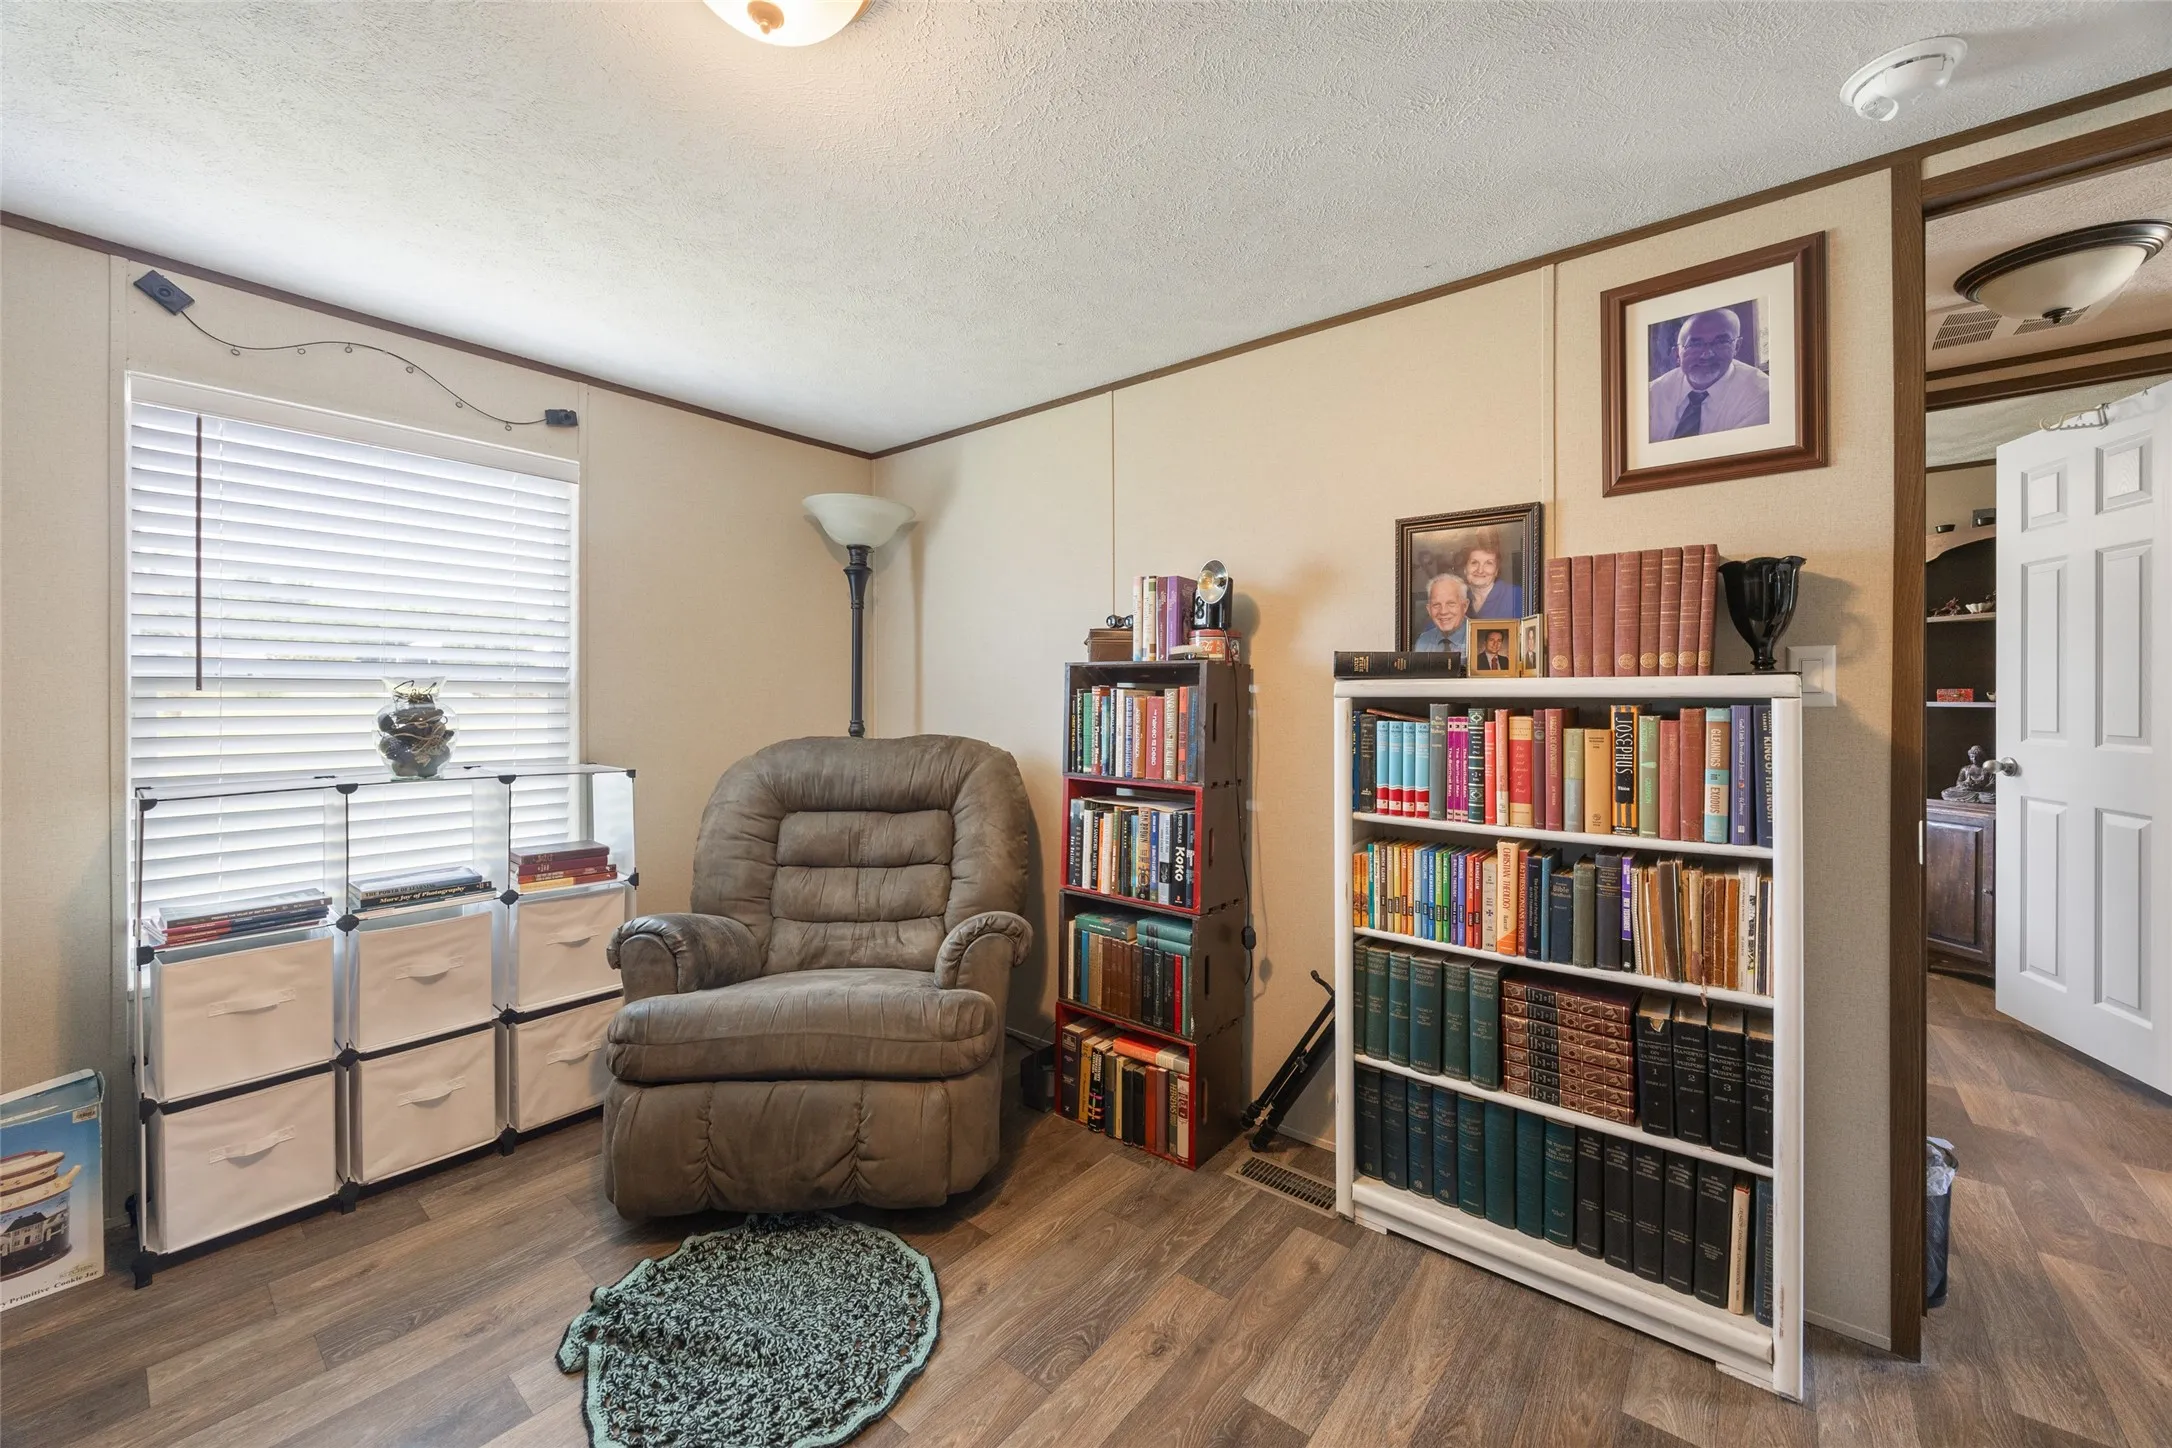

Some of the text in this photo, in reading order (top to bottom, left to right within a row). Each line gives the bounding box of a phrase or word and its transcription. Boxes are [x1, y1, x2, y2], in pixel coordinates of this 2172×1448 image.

[1165, 691, 1175, 766] SANDRA BROWN THE ALIBI
[1549, 716, 1557, 737] TARGETS
[1615, 717, 1633, 774] JOSEPHUS
[1710, 728, 1722, 768] GLEANINGS
[1763, 736, 1773, 762] KING
[1549, 744, 1557, 777] OPPORTUNITY
[1764, 763, 1773, 773] OF
[1710, 773, 1720, 781] in
[1765, 776, 1773, 792] THE
[1709, 786, 1721, 814] EXODUS
[1140, 810, 1149, 844] DAN BROWN
[1174, 846, 1186, 882] KOKO
[1502, 847, 1512, 879] CHRISTIAN
[378, 888, 399, 896] POWER
[408, 883, 436, 892] LEARNING
[379, 896, 398, 904] More
[398, 894, 411, 902] Joy
[422, 886, 466, 898] Photography
[1502, 880, 1511, 911] THEOLOGY
[1687, 1074, 1696, 1082] 2
[1721, 1064, 1733, 1072] ON
[1723, 1083, 1732, 1092] 3
[1761, 1094, 1771, 1102] 4
[9, 1270, 99, 1304] Primitive Cookie Jar
[1762, 1247, 1773, 1310] BIBLE ATLAS
